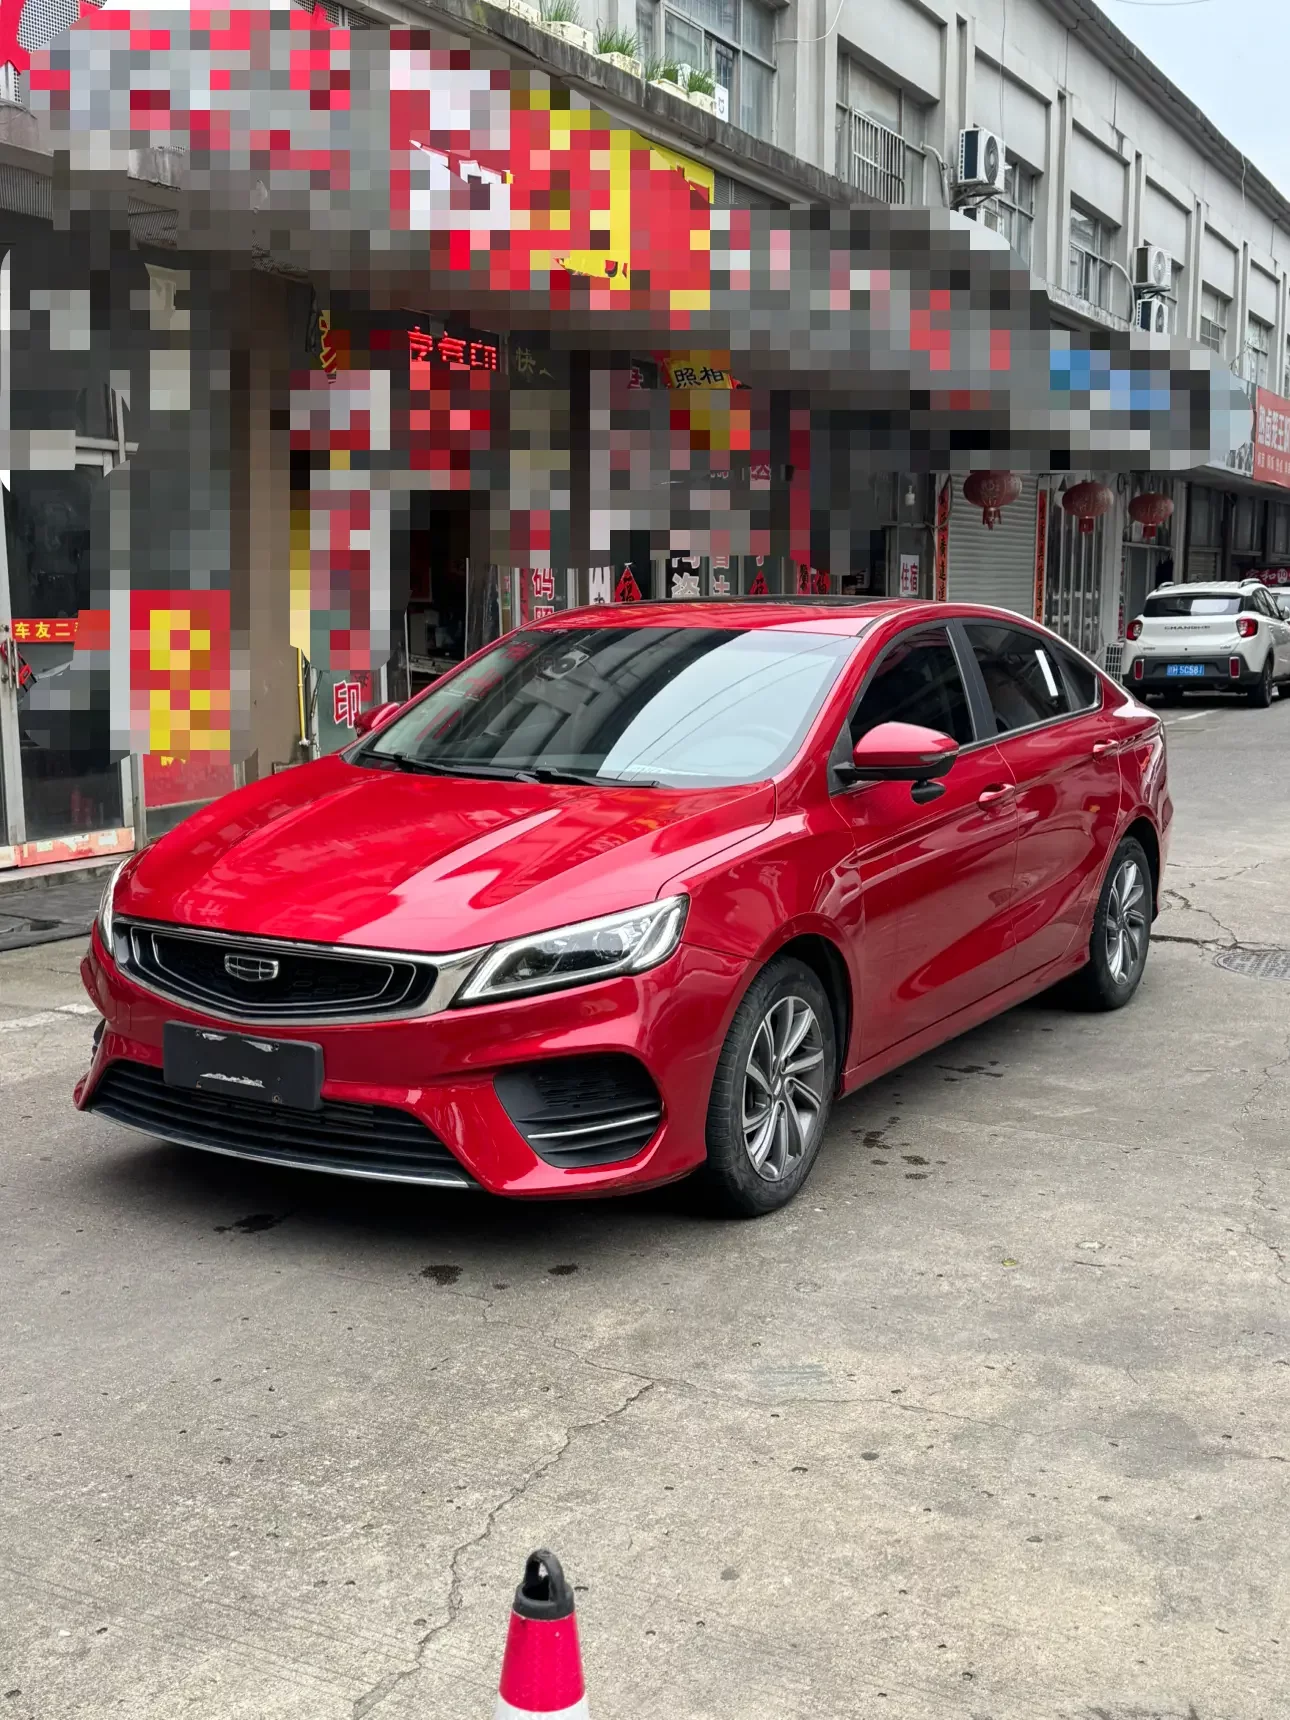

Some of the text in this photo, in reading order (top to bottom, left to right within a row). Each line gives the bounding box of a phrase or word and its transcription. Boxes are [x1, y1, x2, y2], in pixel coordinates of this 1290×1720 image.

[673, 366, 725, 388] 照相
[902, 562, 918, 591] 住宿
[333, 680, 361, 728] 印
